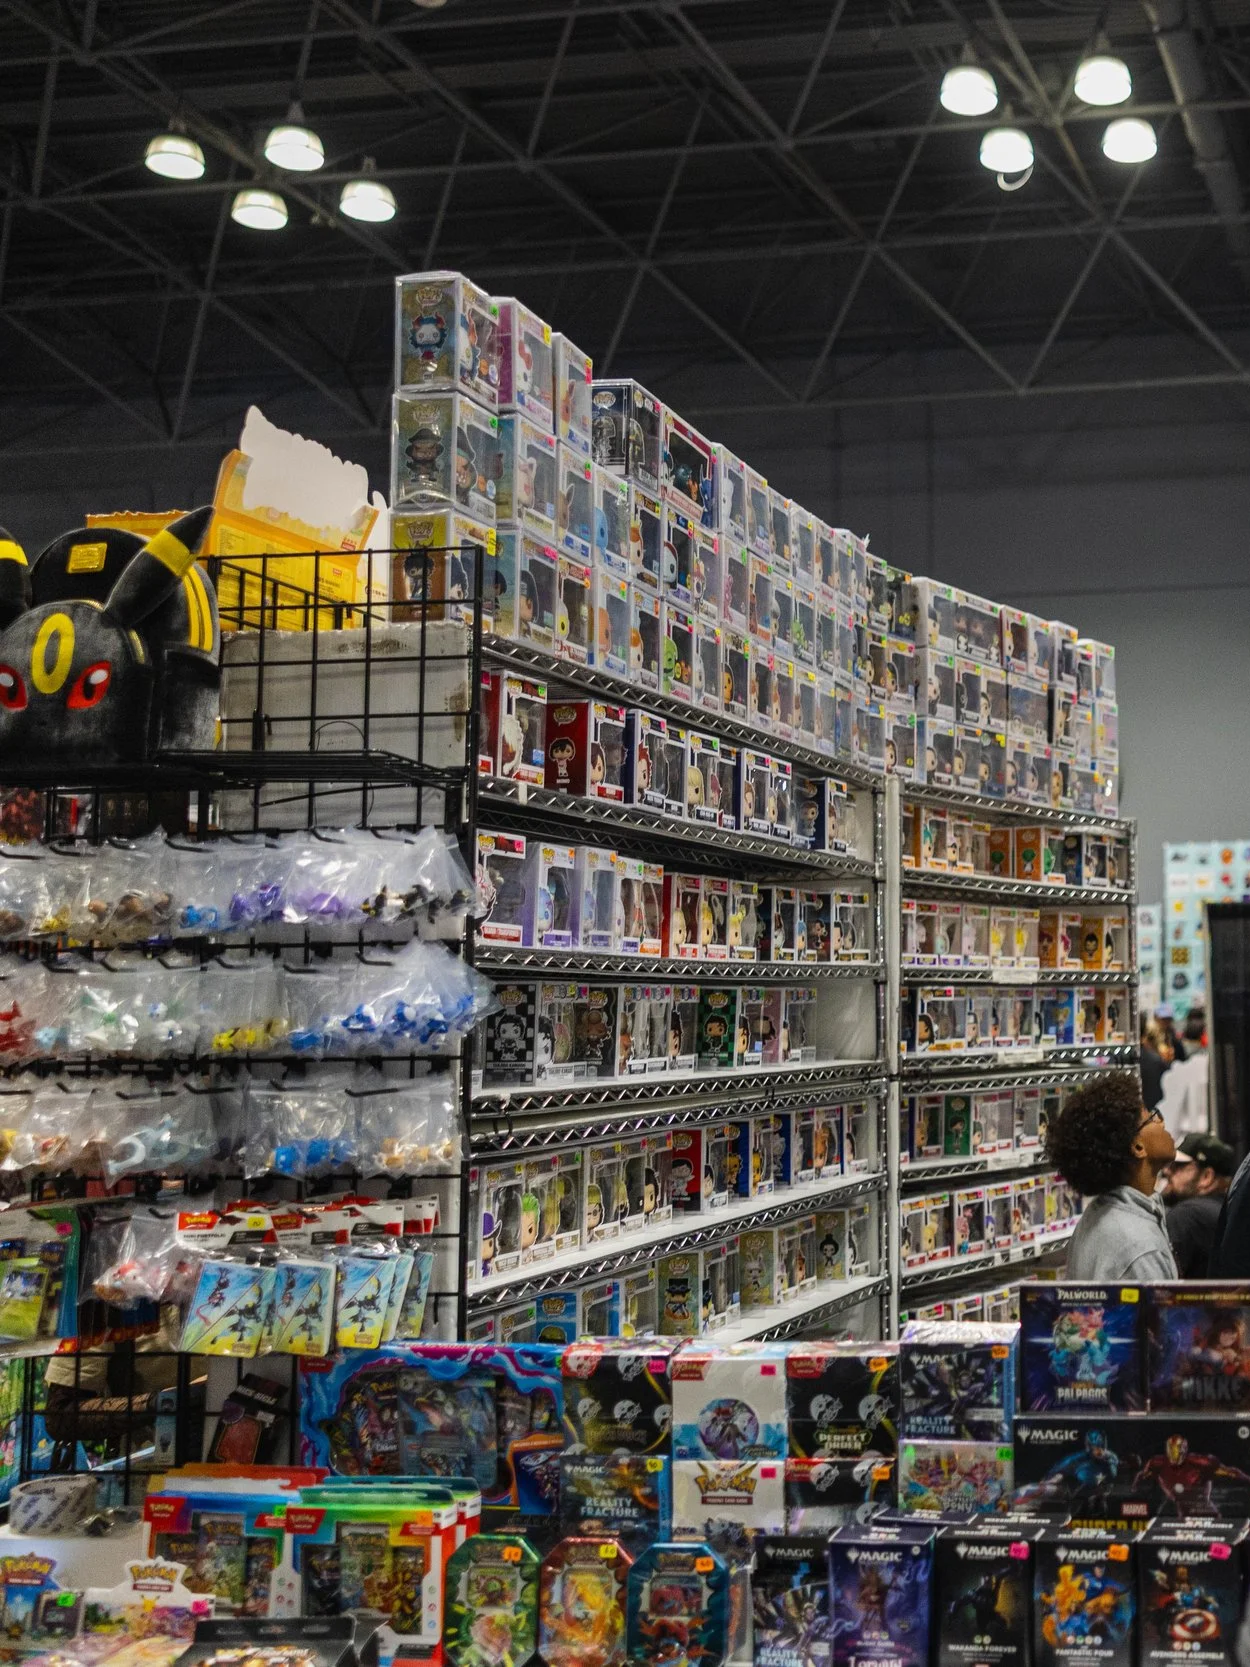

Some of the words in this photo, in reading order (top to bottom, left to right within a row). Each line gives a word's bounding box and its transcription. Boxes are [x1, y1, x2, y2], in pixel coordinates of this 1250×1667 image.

[1057, 1288, 1107, 1300] PALWORLD
[1031, 1430, 1079, 1440] MAGIC
[573, 1465, 604, 1474] MAGIC
[586, 1497, 633, 1507] REALITY
[581, 1506, 639, 1518] FRACTURE
[775, 1548, 813, 1558] MAGIC
[966, 1545, 1009, 1556] MAGIC
[1067, 1550, 1109, 1560] MAGIC
[857, 1551, 902, 1562] MAGIC
[1169, 1551, 1211, 1562] MAGIC
